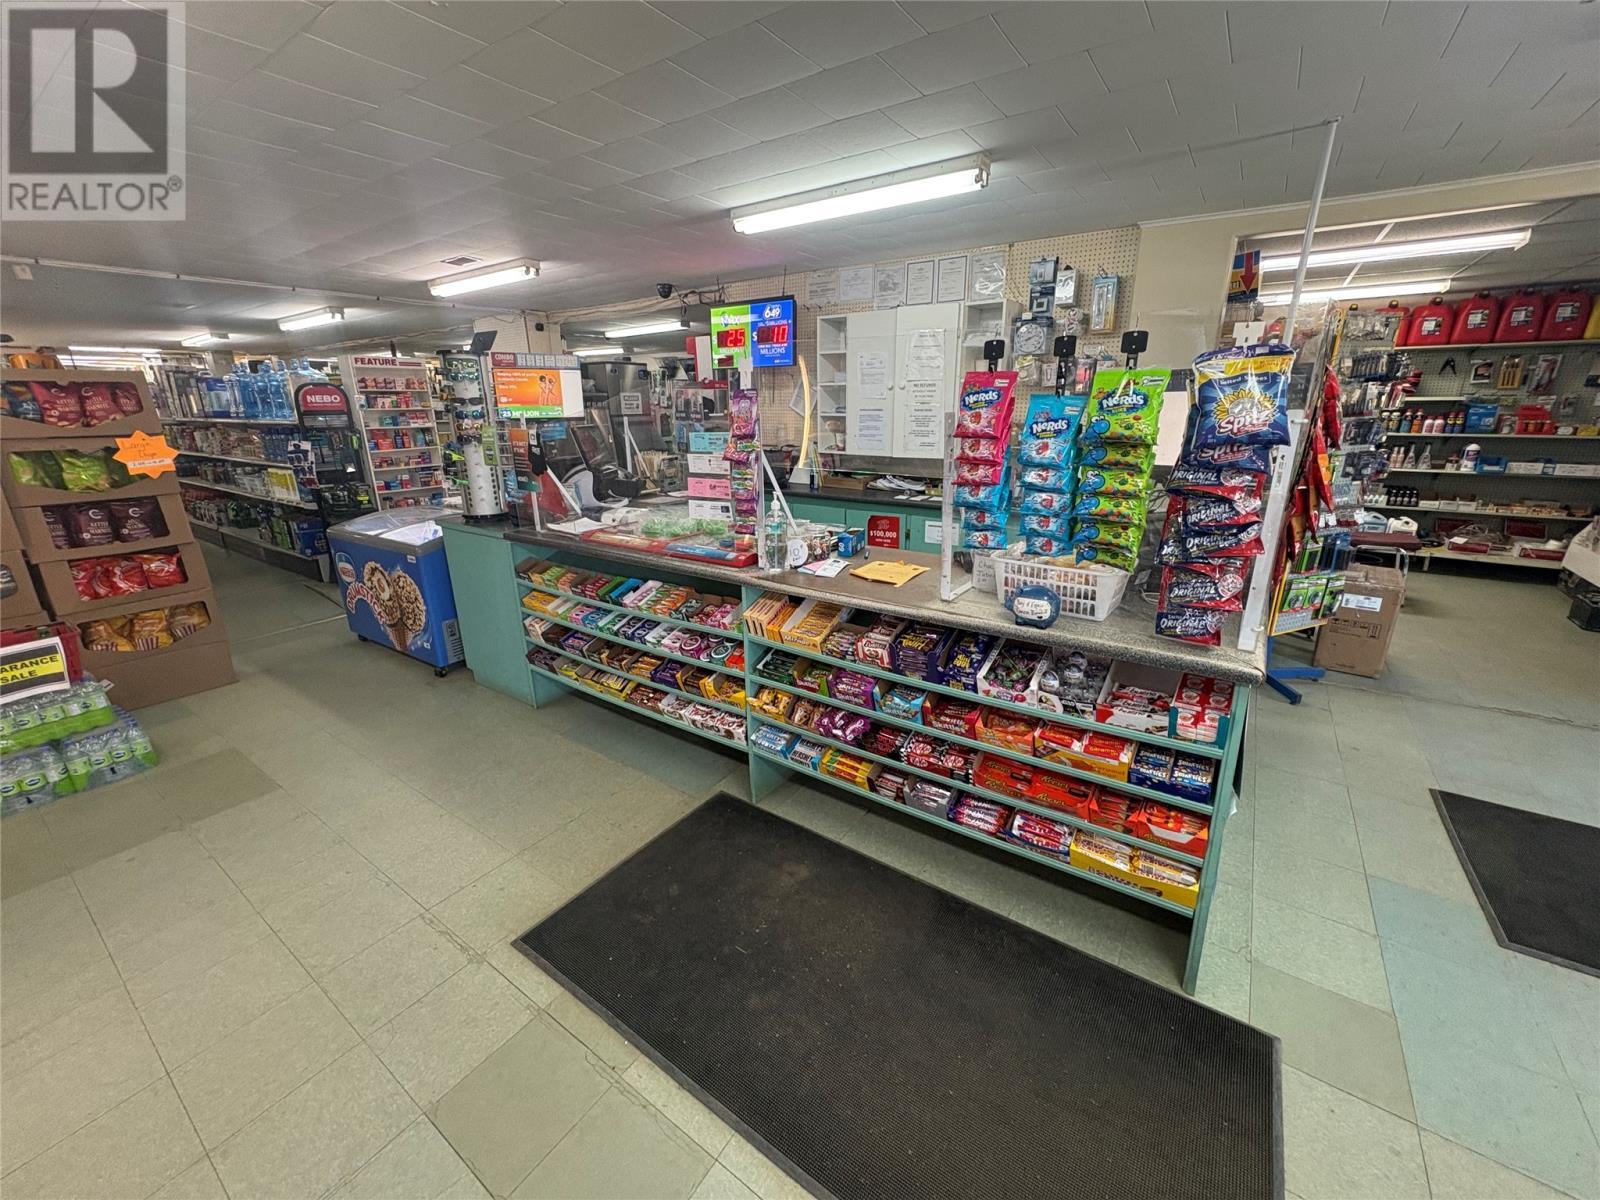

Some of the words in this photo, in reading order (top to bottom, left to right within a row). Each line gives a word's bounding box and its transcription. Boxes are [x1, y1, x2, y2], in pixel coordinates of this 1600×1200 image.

[727, 330, 745, 347] 25
[773, 325, 788, 343] 10
[760, 347, 786, 355] MILLIONS
[354, 357, 398, 367] FEATURE
[305, 394, 341, 404] NEBO
[1169, 585, 1216, 598] ORIGINAL
[0, 670, 37, 684] SALE
[1174, 770, 1208, 783] SMARTIES
